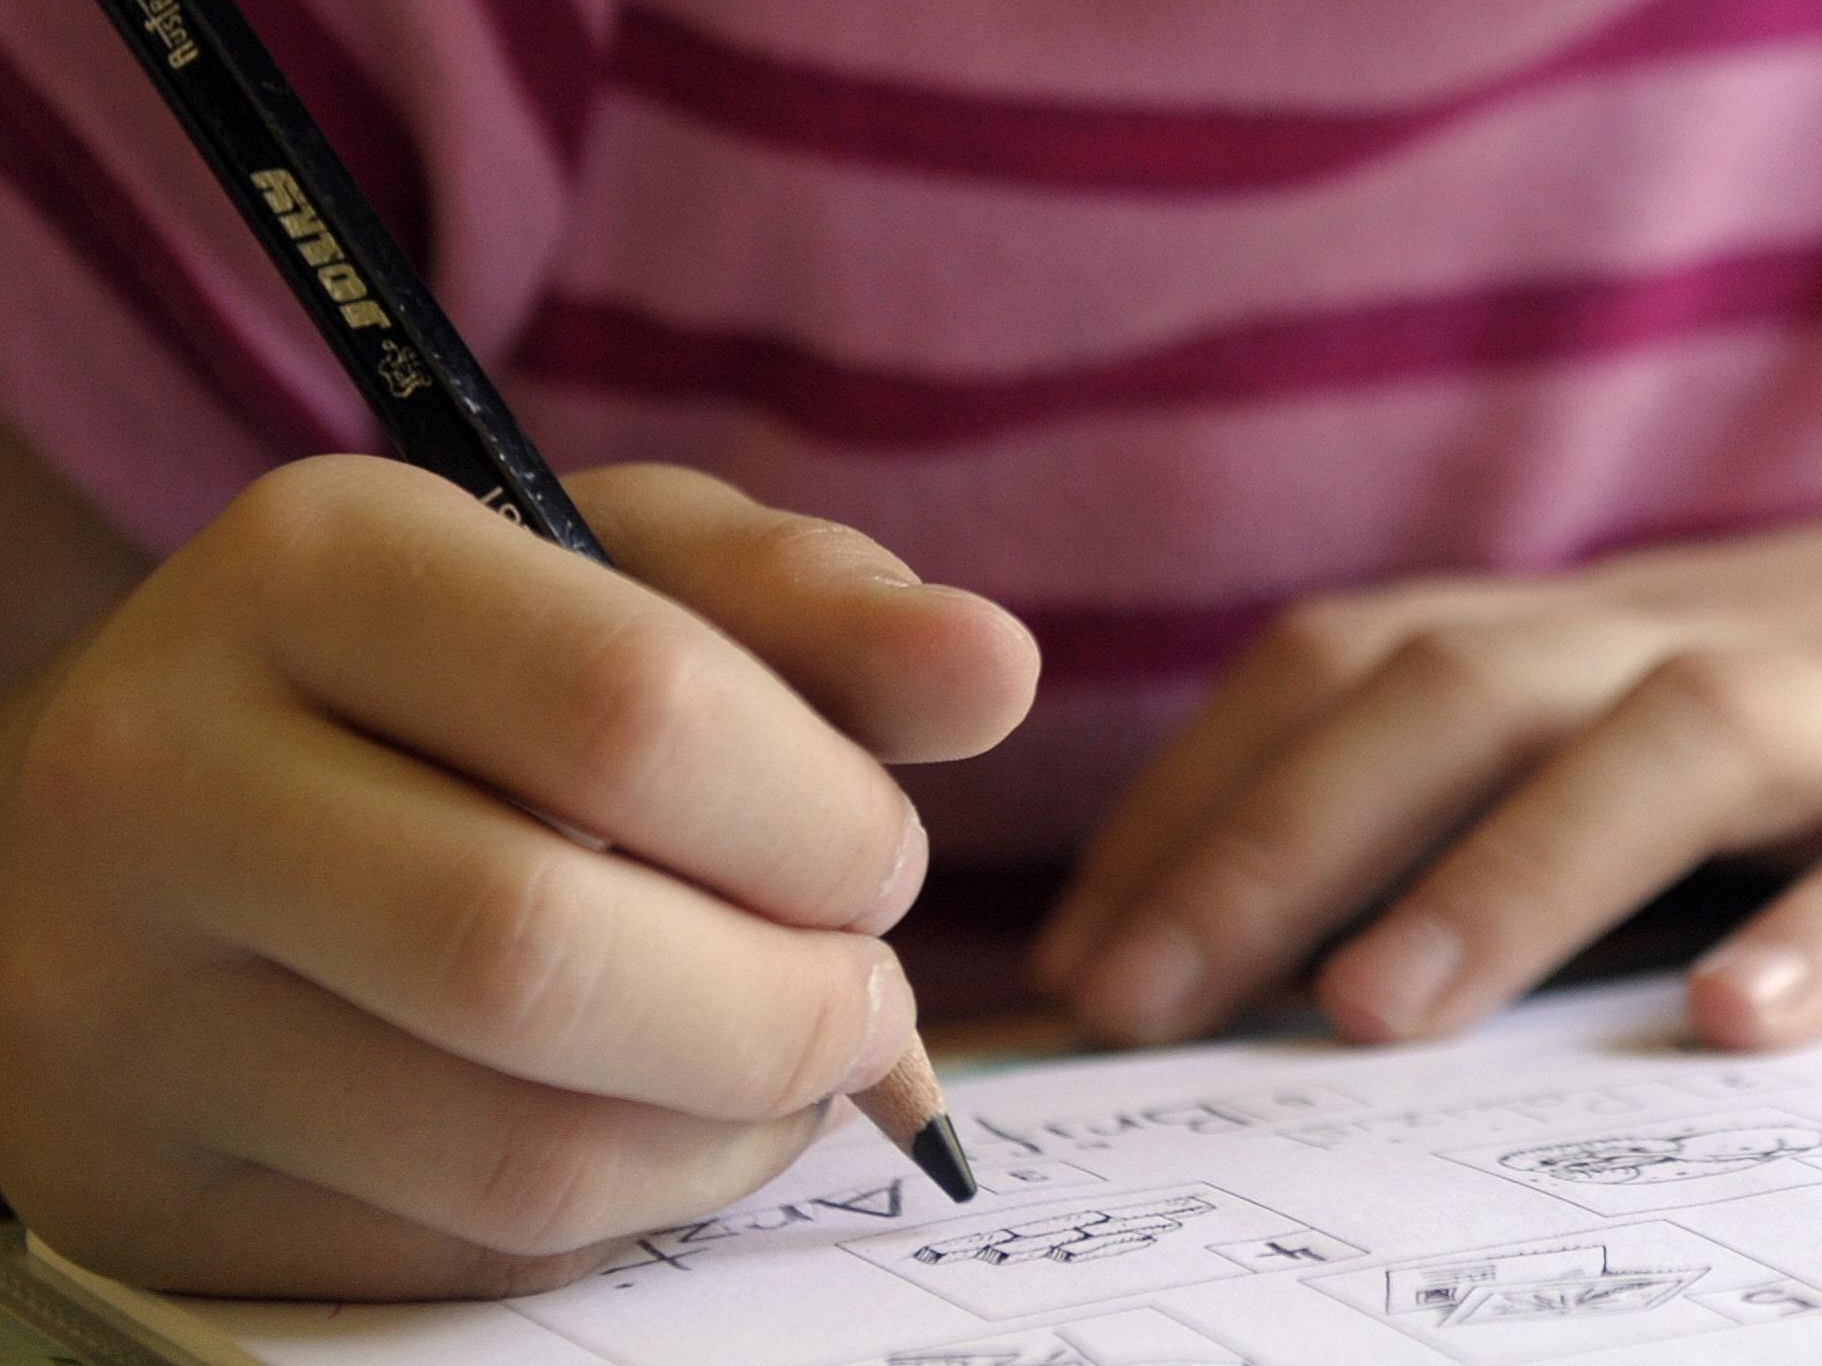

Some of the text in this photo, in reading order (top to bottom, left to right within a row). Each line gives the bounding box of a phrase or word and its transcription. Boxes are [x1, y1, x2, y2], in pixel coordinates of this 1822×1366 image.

[250, 167, 392, 332] JOLLY
[1254, 1241, 1329, 1263] 4
[1740, 1289, 1820, 1318] 5
